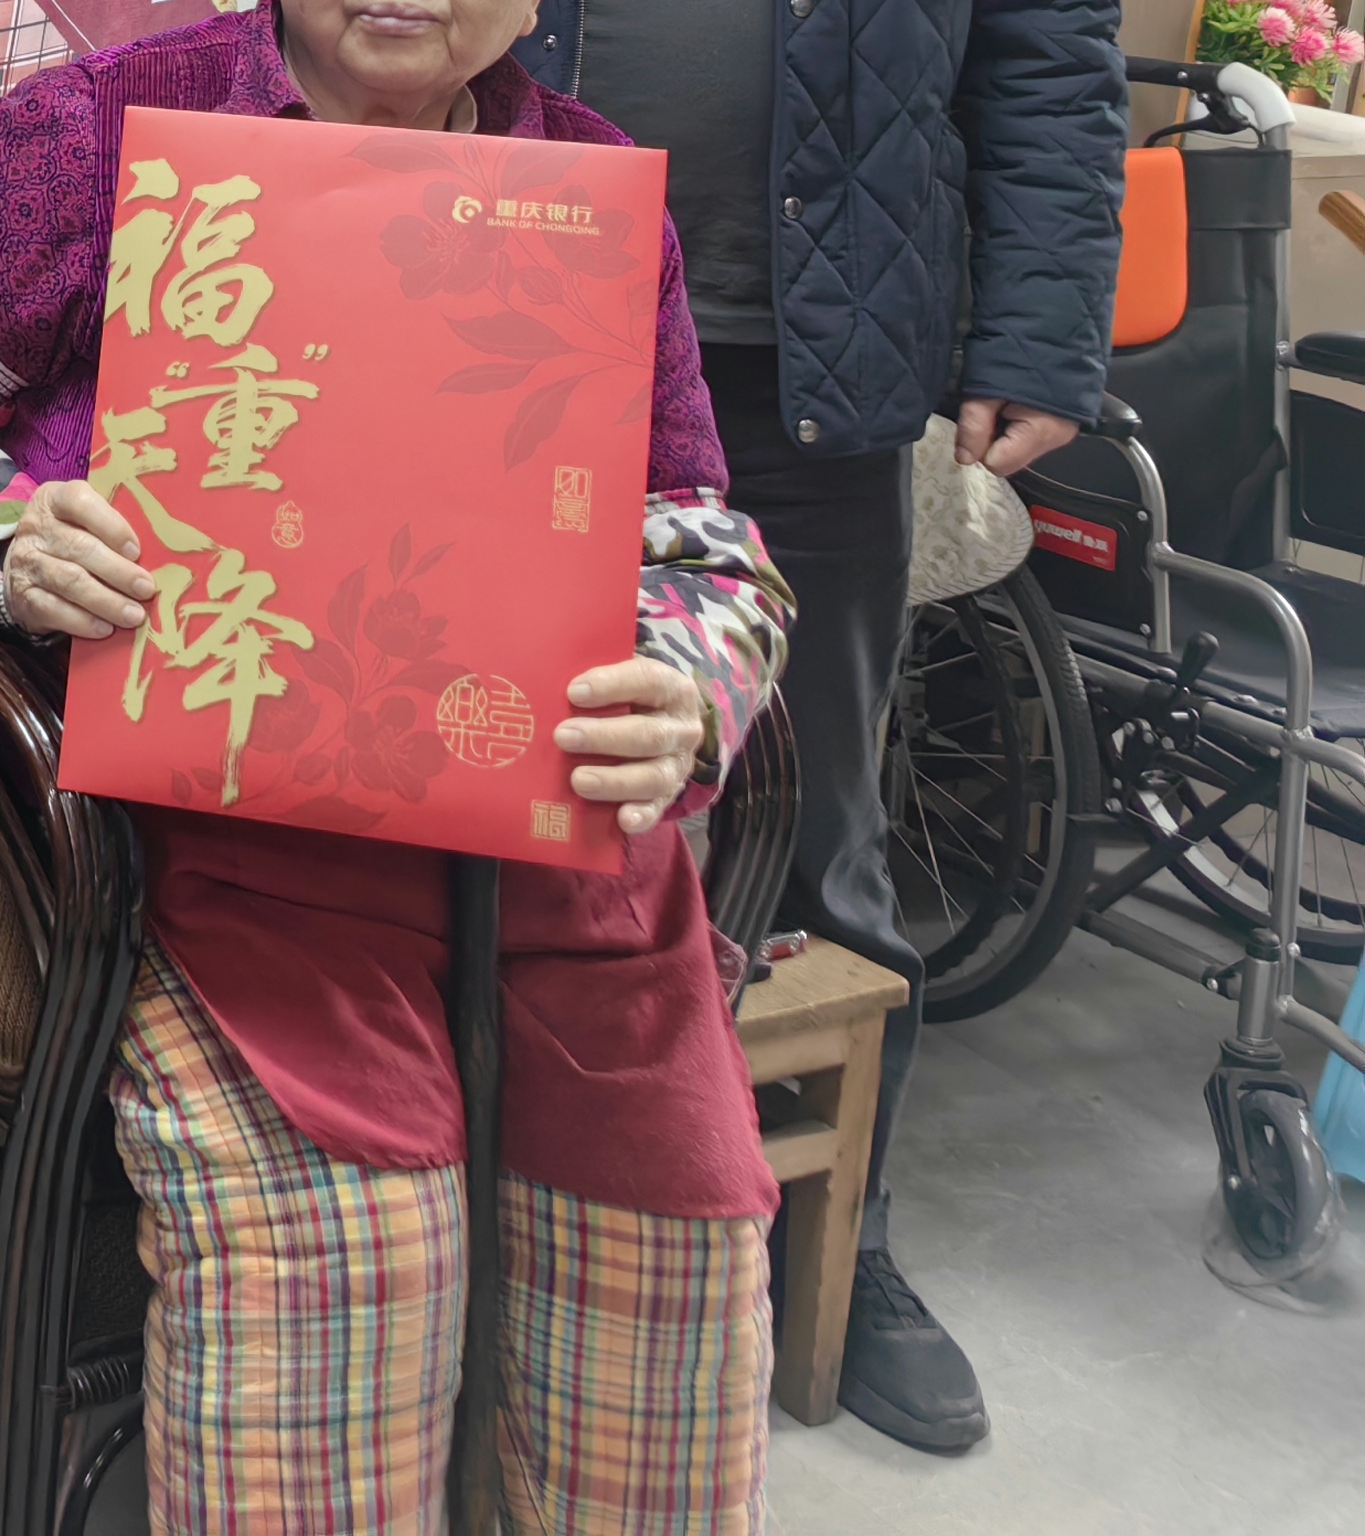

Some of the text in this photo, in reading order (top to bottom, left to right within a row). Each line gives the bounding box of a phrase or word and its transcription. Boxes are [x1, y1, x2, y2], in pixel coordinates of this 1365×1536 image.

[495, 198, 594, 224] 重庆银行
[487, 217, 600, 236] BANK OF CHONGQING
[531, 798, 572, 842] 福
